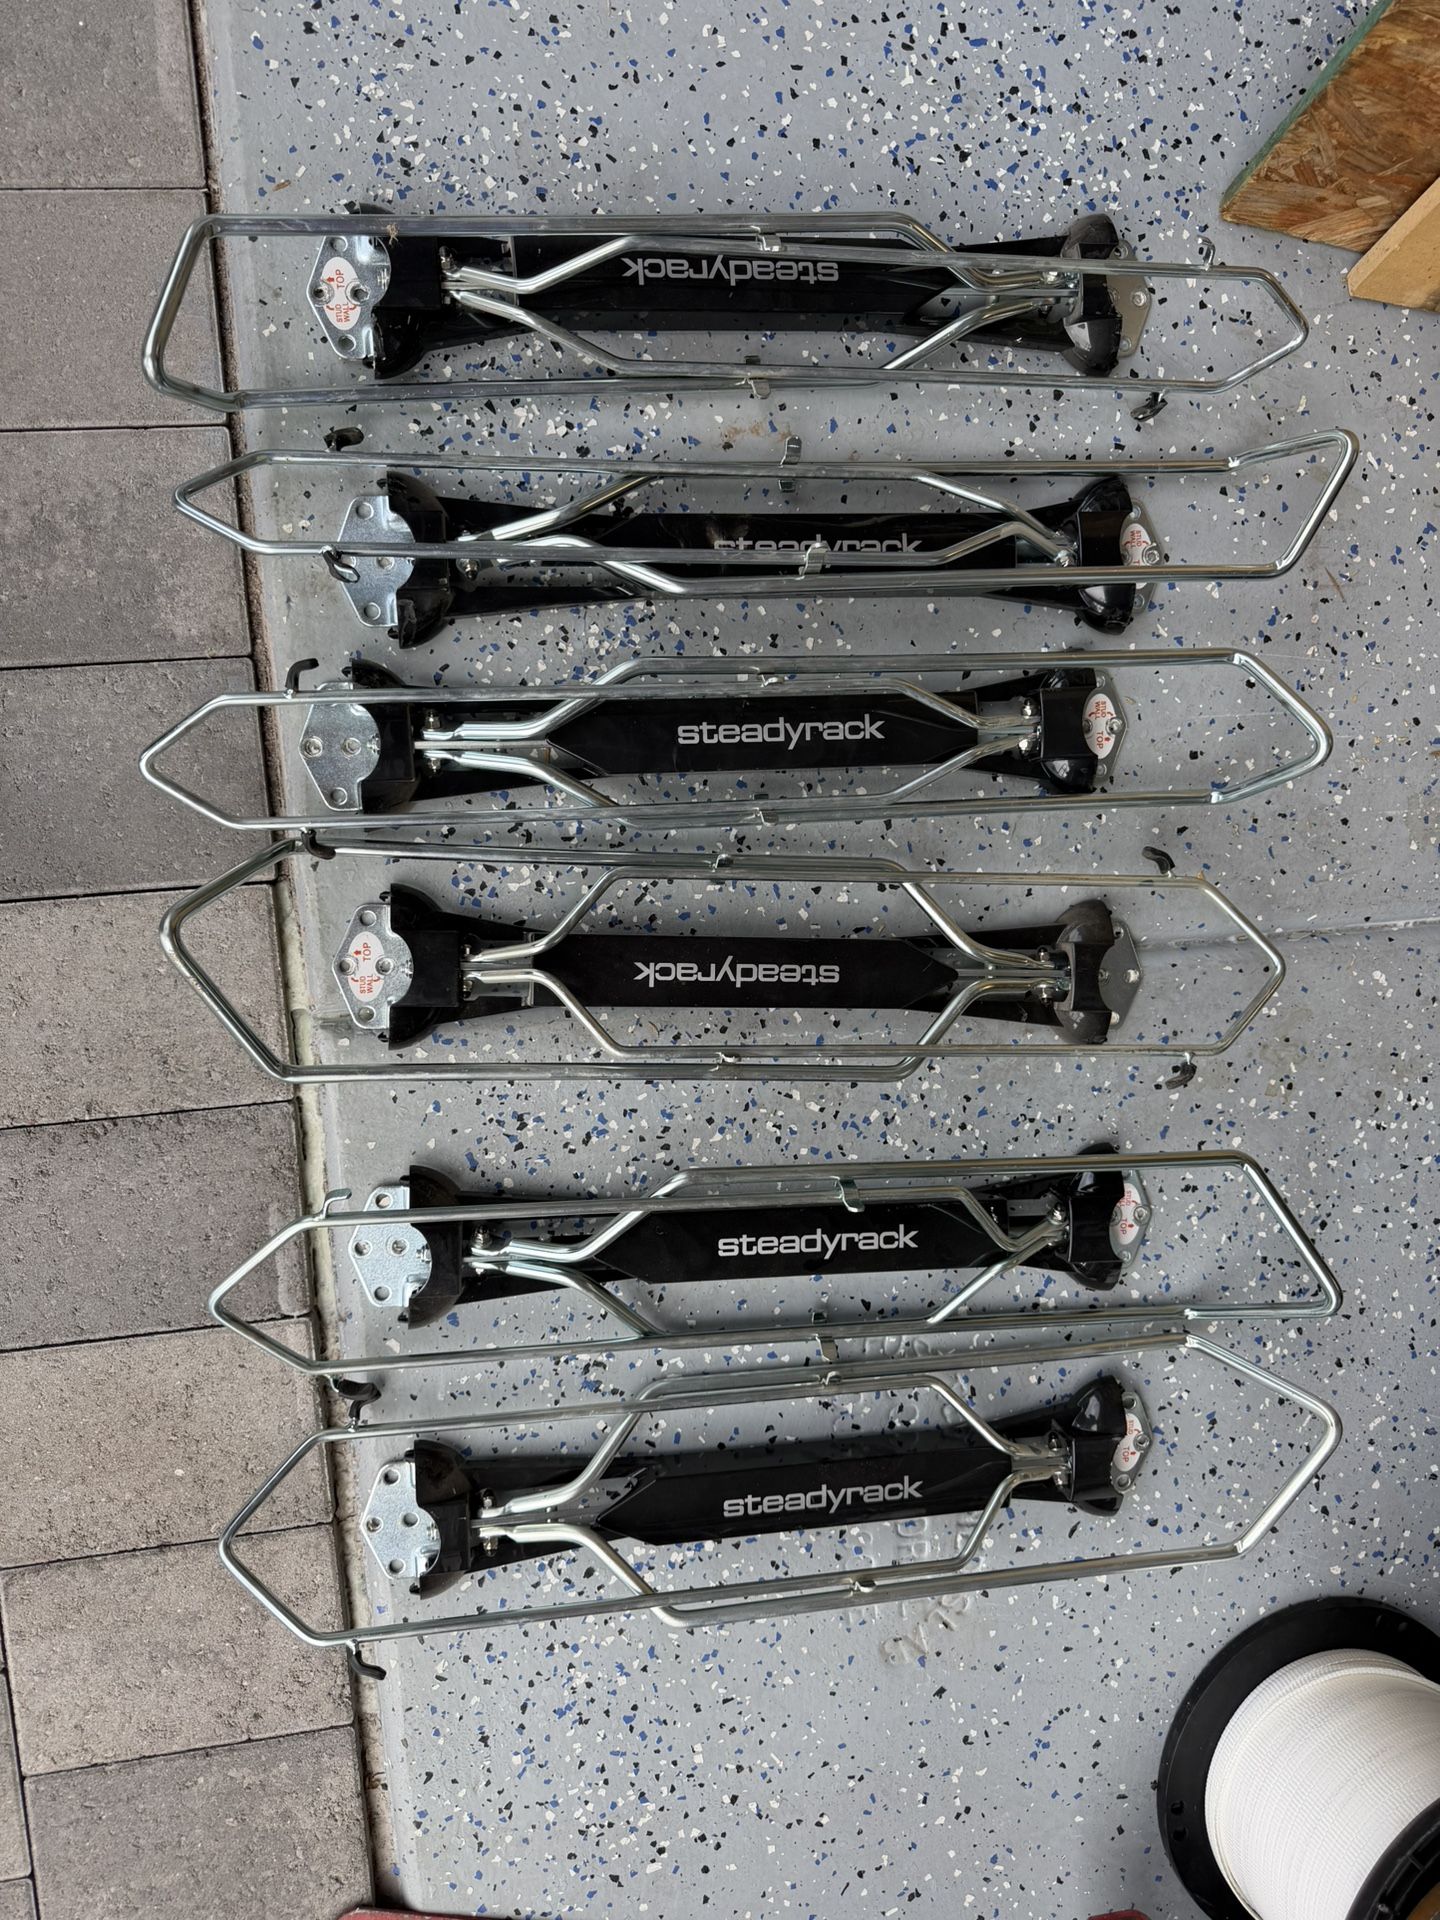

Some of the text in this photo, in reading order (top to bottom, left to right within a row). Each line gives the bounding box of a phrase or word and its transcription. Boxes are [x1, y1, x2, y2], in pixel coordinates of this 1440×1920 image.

[335, 269, 345, 289] TOP
[621, 254, 839, 286] steadyrack
[335, 304, 343, 323] STUD
[343, 302, 351, 323] WALL
[677, 713, 885, 750] steadyrack
[1096, 731, 1104, 749] TOP
[362, 942, 372, 962] TOP
[633, 955, 840, 988] steadyrack
[718, 1223, 919, 1260] steadyrack
[1122, 1446, 1130, 1462] TOP
[723, 1475, 924, 1518] steadyrack
